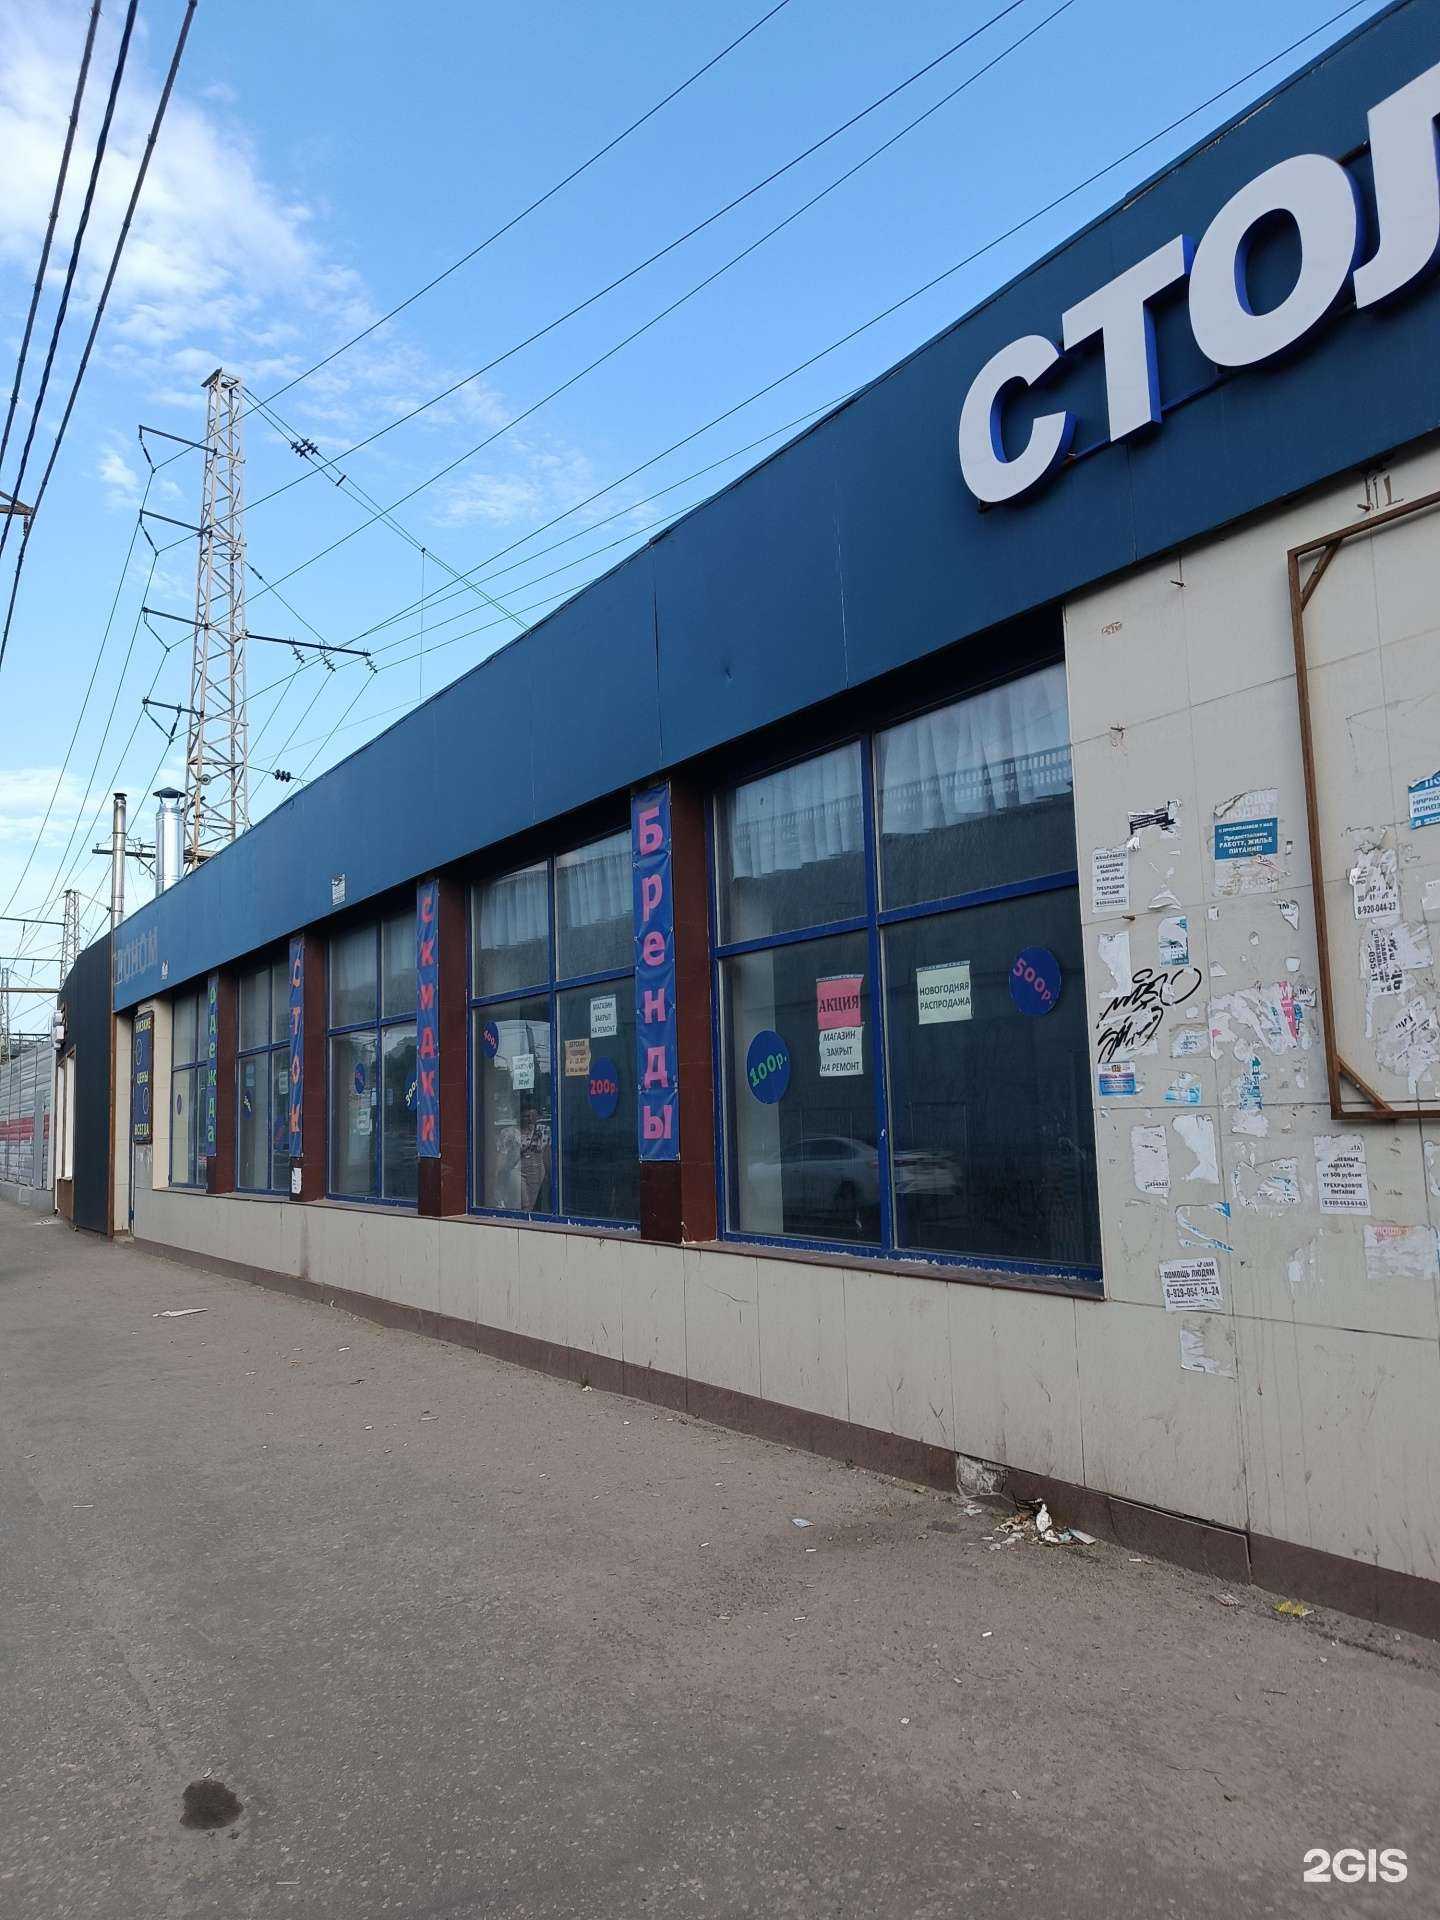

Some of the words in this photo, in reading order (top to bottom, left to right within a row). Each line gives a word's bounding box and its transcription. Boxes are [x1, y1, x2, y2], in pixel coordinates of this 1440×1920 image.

[919, 981, 970, 996] НОВОГОДНЯЯ
[1012, 958, 1053, 1005] 500р.
[818, 995, 859, 1014] АКЦИЯ
[919, 997, 971, 1011] РАСПРОДАЖА
[823, 1030, 856, 1042] МАГАЗИН
[826, 1046, 853, 1057] ЗАКРЫТ
[749, 1052, 788, 1088] 100р.
[820, 1063, 831, 1073] НА
[831, 1061, 860, 1072] РЕМОНТ
[1163, 1269, 1191, 1280] ПОМОЩЬ
[1191, 1267, 1216, 1278] ЛЮДЯМ
